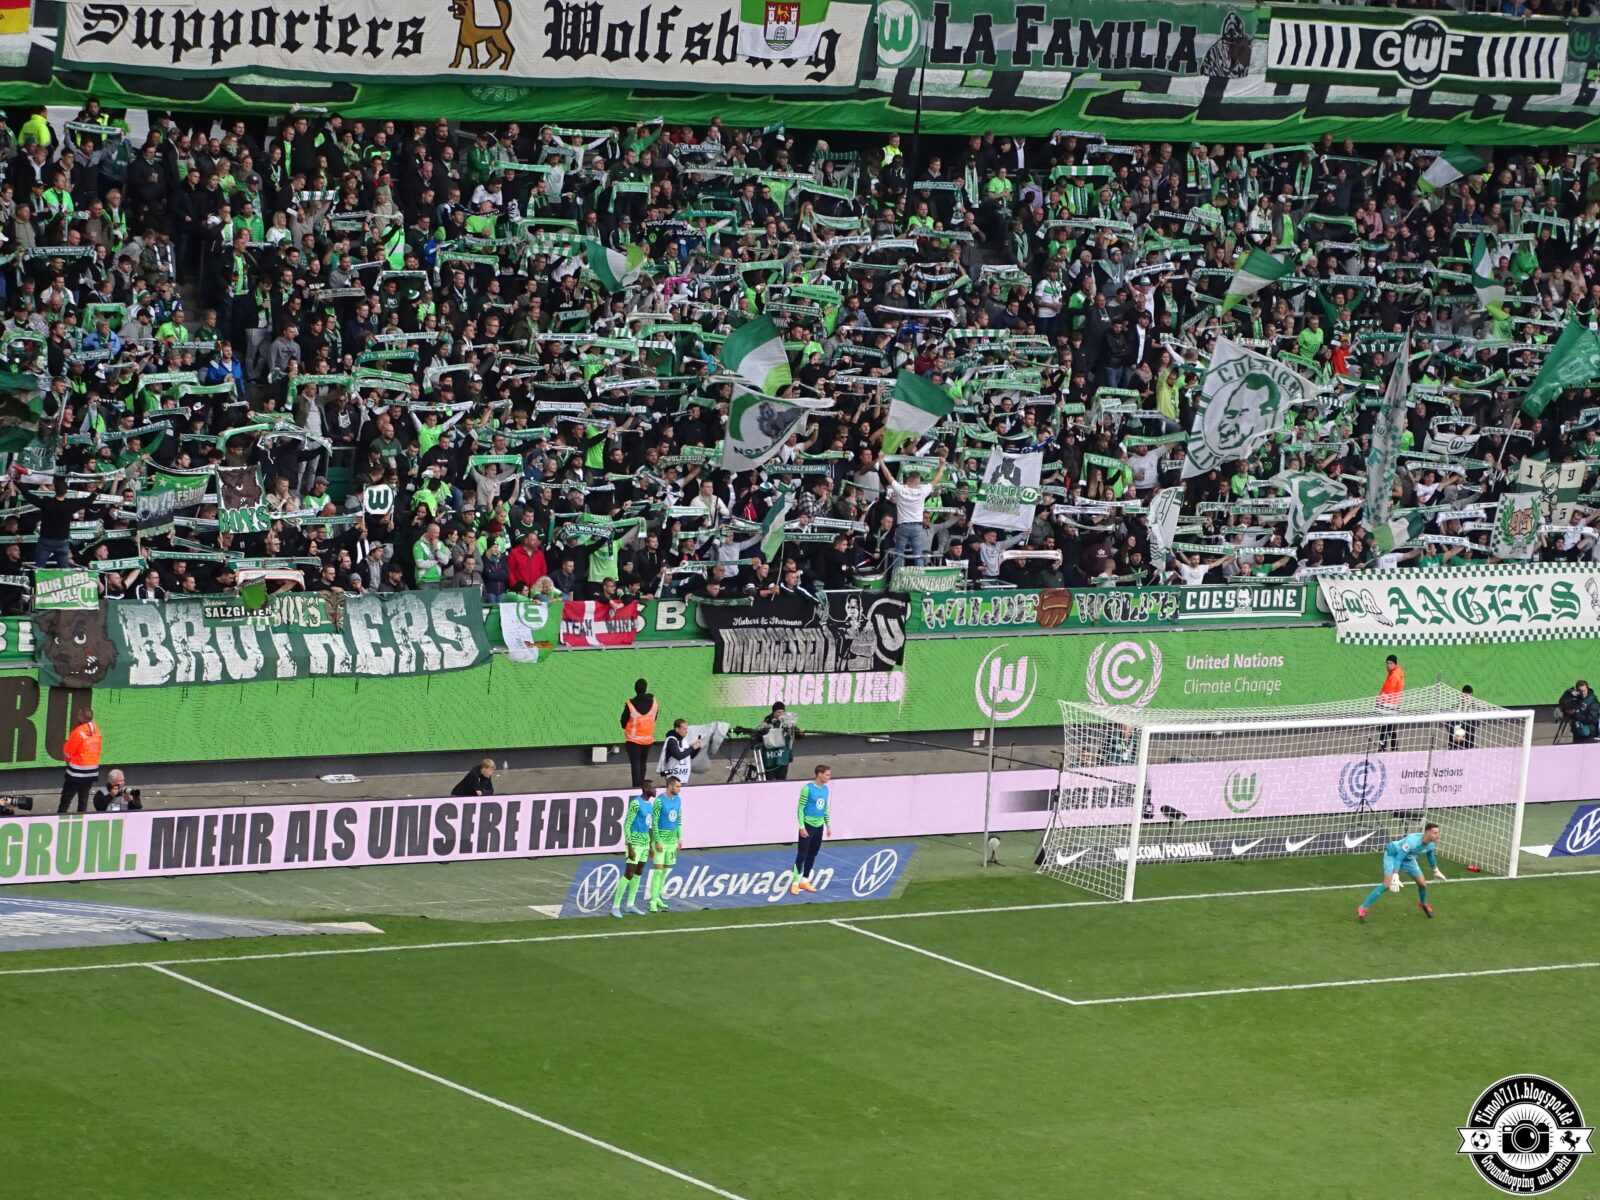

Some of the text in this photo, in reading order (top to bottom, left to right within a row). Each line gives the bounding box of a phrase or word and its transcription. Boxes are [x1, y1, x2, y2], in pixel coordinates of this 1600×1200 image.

[77, 0, 841, 82] Supporters Wolfsbg
[1372, 30, 1466, 74] GWF
[219, 506, 272, 534] BOYS
[205, 605, 272, 618] SALZGIER
[921, 591, 1180, 629] WILDE WÖLFE
[1387, 580, 1582, 626] ANGELS
[562, 617, 594, 638] TEAM
[1186, 652, 1284, 671] United Nations
[768, 671, 905, 706] RACE TO ZERO
[1183, 677, 1282, 696] Climate Change
[1401, 767, 1464, 779] United Nations
[1399, 782, 1463, 795] Climate Change
[0, 796, 638, 879] GRÜN. MEHR ALS UNSERE FARB
